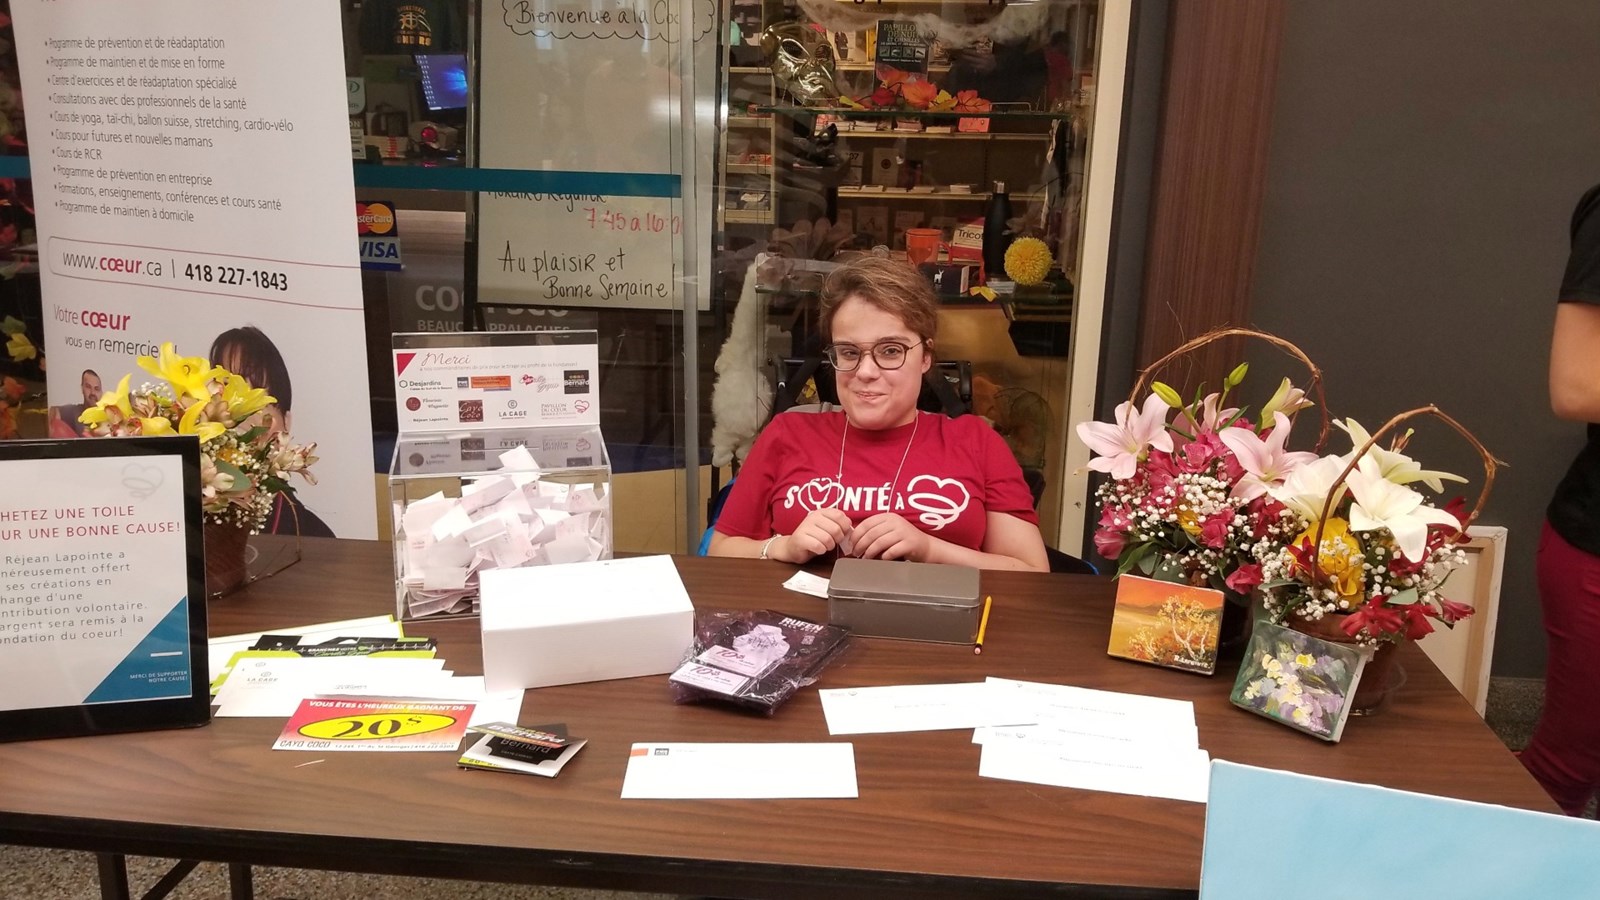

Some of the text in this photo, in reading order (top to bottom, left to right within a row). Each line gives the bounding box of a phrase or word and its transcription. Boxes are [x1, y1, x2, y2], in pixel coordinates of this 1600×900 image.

[513, 1, 611, 25] Bienvenue
[883, 23, 917, 32] PAPILLO
[49, 36, 225, 51] Programme de prévention et de réadaptation
[50, 56, 225, 70] Programme de maintien et de mise en forme
[52, 75, 237, 91] Centre d'exercices et de réadaptation spécialisé
[53, 93, 247, 110] Consultations avec des professionnels de la santé
[54, 111, 70, 123] Cours
[71, 111, 80, 123] de
[81, 114, 104, 126] yoga,
[137, 114, 162, 126] ballon
[164, 115, 192, 128] suisse,
[195, 116, 242, 132] stretching,
[244, 118, 294, 132] cardio-vélo
[55, 128, 213, 148] Cours pour futures et nouvelles mamans
[56, 147, 103, 160] Cours de RCR
[57, 164, 213, 187] Programme de prévention en entreprise
[58, 182, 282, 211] Formations, enseignements, conférences et cours santé
[60, 199, 194, 223] Programme de maintien à domicile
[357, 214, 393, 224] sterCard
[497, 240, 526, 273] Au
[605, 247, 626, 272] et
[62, 252, 288, 291] www.cœur.ca 418 227-1843
[542, 275, 593, 300] Bonne
[53, 304, 132, 331] Votre cœur
[65, 335, 83, 348] vous
[85, 339, 96, 350] en
[421, 352, 471, 367] Merci
[409, 379, 442, 388] Desjardins
[54, 508, 86, 520] UNE
[92, 505, 135, 518] TOILE
[28, 527, 60, 539] UNE
[66, 524, 120, 538] BONNE
[126, 521, 181, 534] CAUSE!
[5, 551, 125, 566] Réjean Lapointe a
[92, 563, 131, 574] offert
[6, 577, 112, 592] ses créations en
[46, 592, 83, 602] d'une
[76, 601, 148, 613] volontaire.
[48, 619, 75, 628] sera
[80, 617, 116, 626] remis
[120, 615, 127, 624] à
[132, 613, 144, 623] la
[61, 631, 77, 641] du
[82, 630, 124, 640] coeur!
[335, 700, 356, 708] ÊTES
[358, 702, 406, 710] L'HEUREUX
[306, 741, 332, 749] COCO
